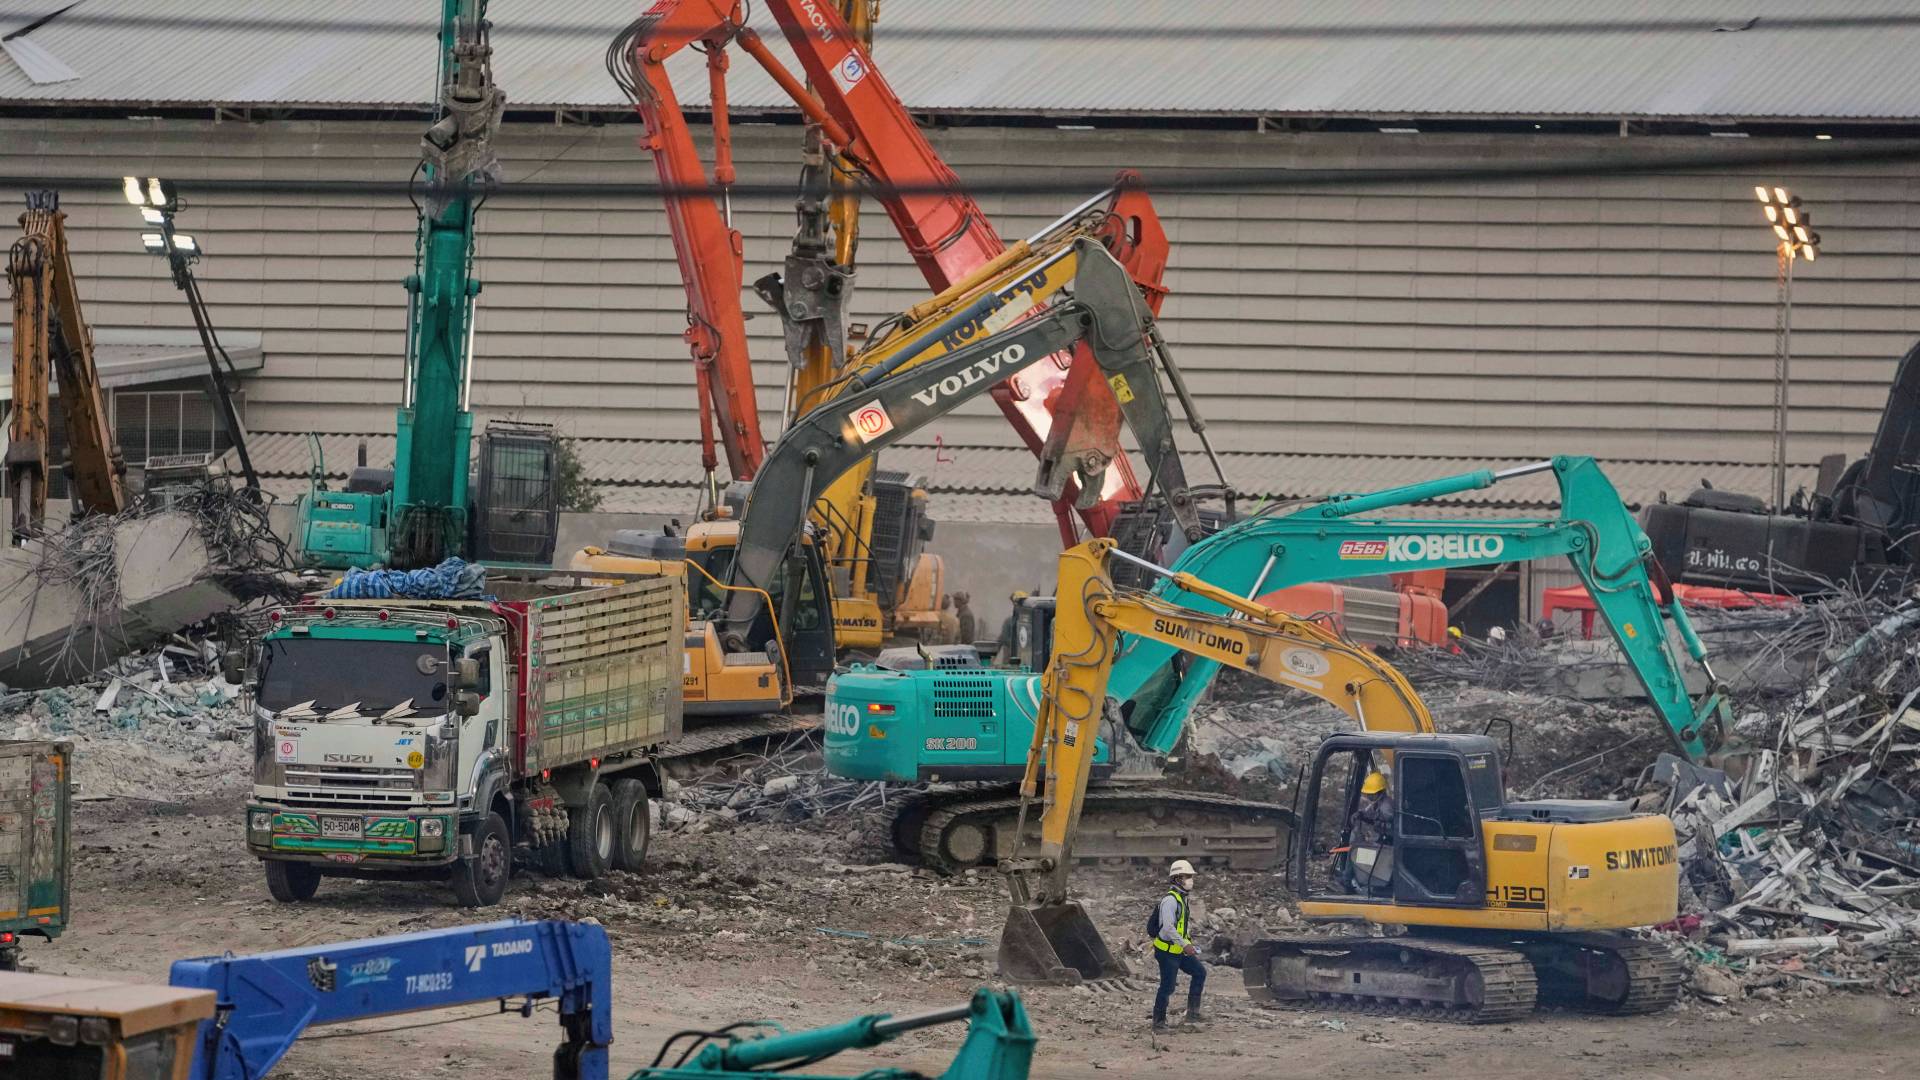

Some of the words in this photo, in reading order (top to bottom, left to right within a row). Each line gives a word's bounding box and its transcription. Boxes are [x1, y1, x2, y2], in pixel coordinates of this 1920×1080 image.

[801, 0, 833, 43] ACHI
[911, 344, 1025, 406] VOLVO
[1388, 535, 1504, 562] KOBELCO
[1154, 619, 1244, 655] SUMITOMO
[323, 753, 373, 764] ISUZU
[323, 821, 360, 832] 50-5048
[491, 939, 533, 957] TADANO
